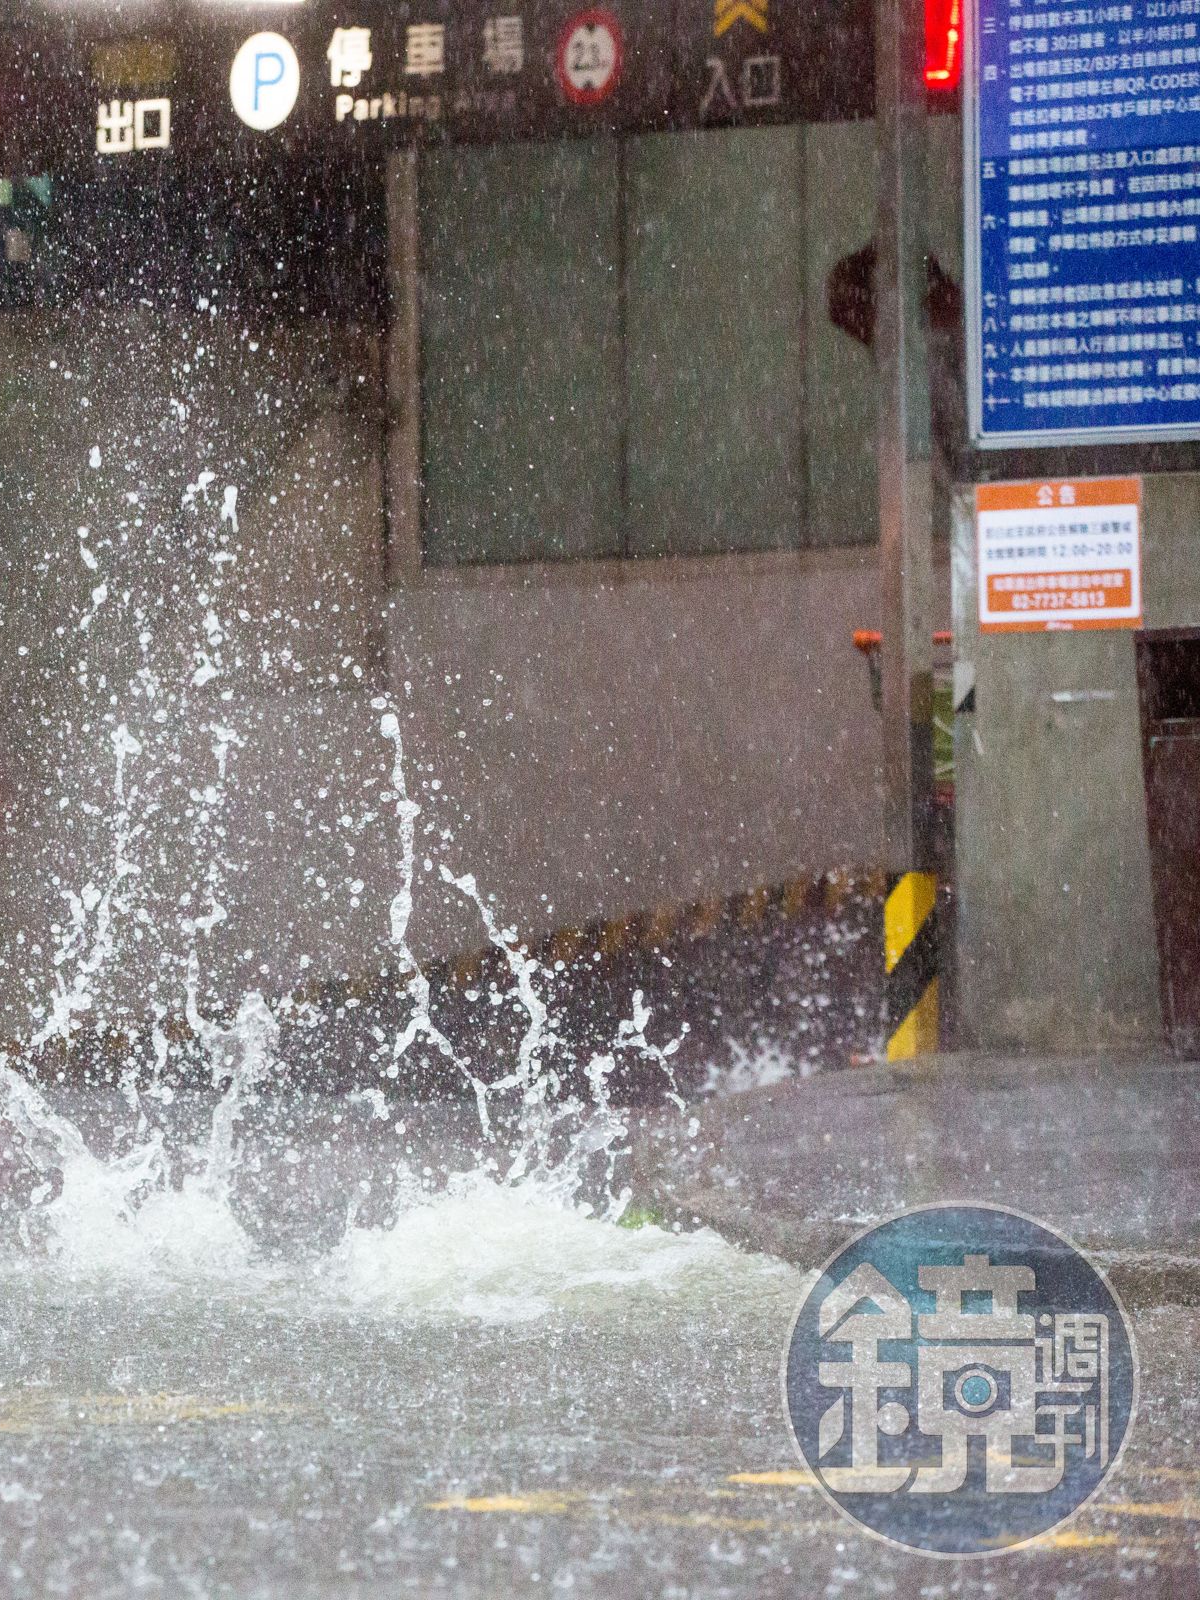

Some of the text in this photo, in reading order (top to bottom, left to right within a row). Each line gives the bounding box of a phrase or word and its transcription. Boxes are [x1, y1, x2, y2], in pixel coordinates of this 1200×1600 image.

[254, 52, 286, 111] P
[334, 92, 442, 123] Parking
[700, 56, 781, 116] 入口
[96, 98, 171, 153] 出口
[1036, 485, 1076, 505] 公告
